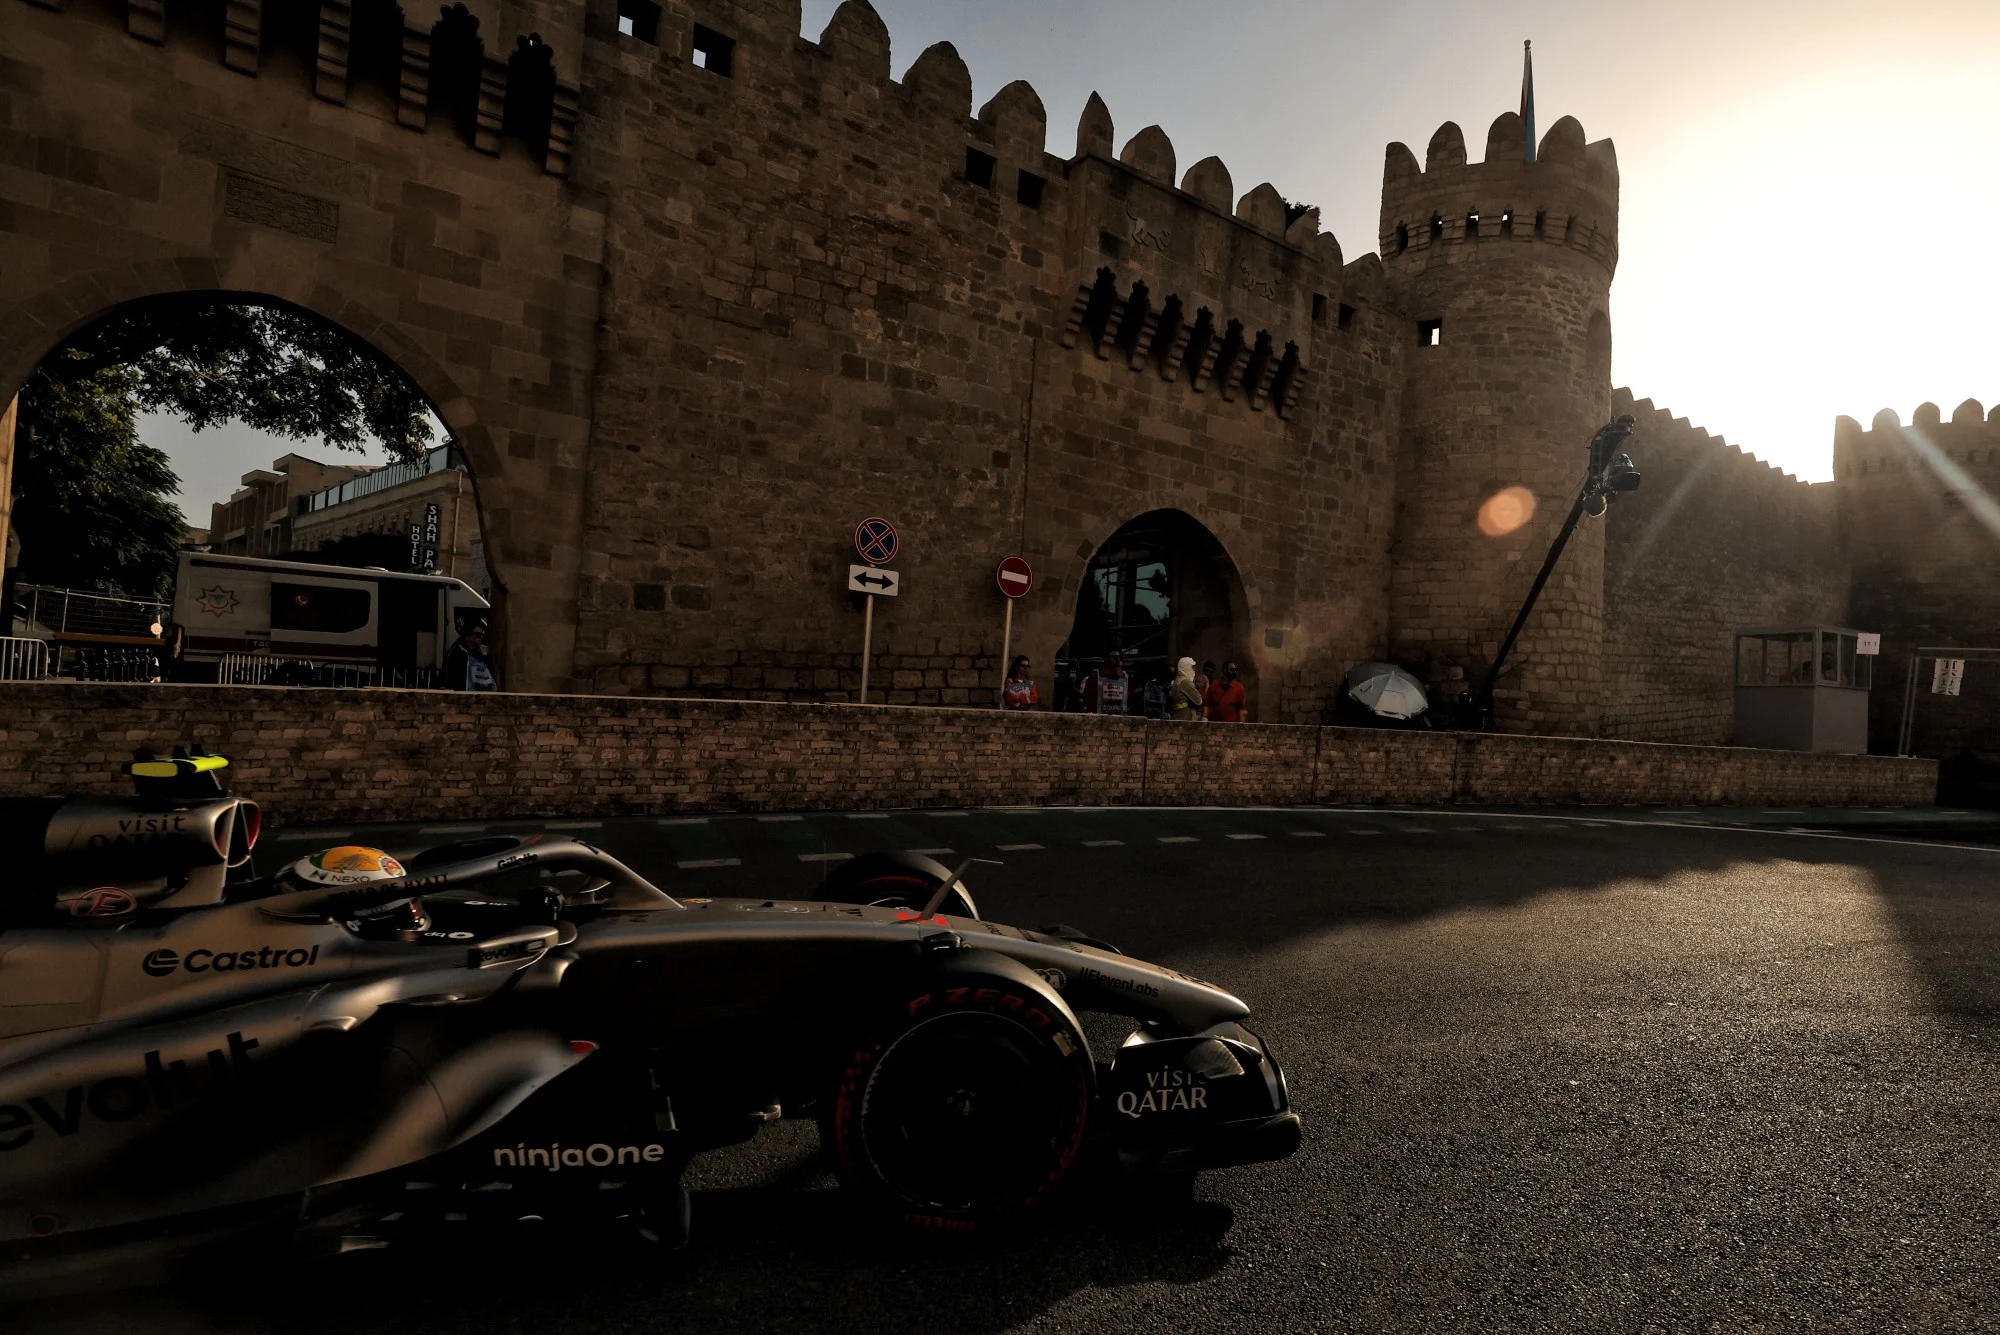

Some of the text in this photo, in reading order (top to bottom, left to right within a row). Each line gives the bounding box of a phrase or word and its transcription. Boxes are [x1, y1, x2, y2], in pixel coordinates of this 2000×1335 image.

[410, 525, 421, 565] HOTEL
[423, 505, 438, 569] SHAH PA
[119, 815, 186, 833] visit
[331, 875, 370, 884] NEXO
[184, 944, 319, 973] Castrol
[1117, 1086, 1208, 1118] QATAR
[493, 1142, 665, 1172] ninjaOne
